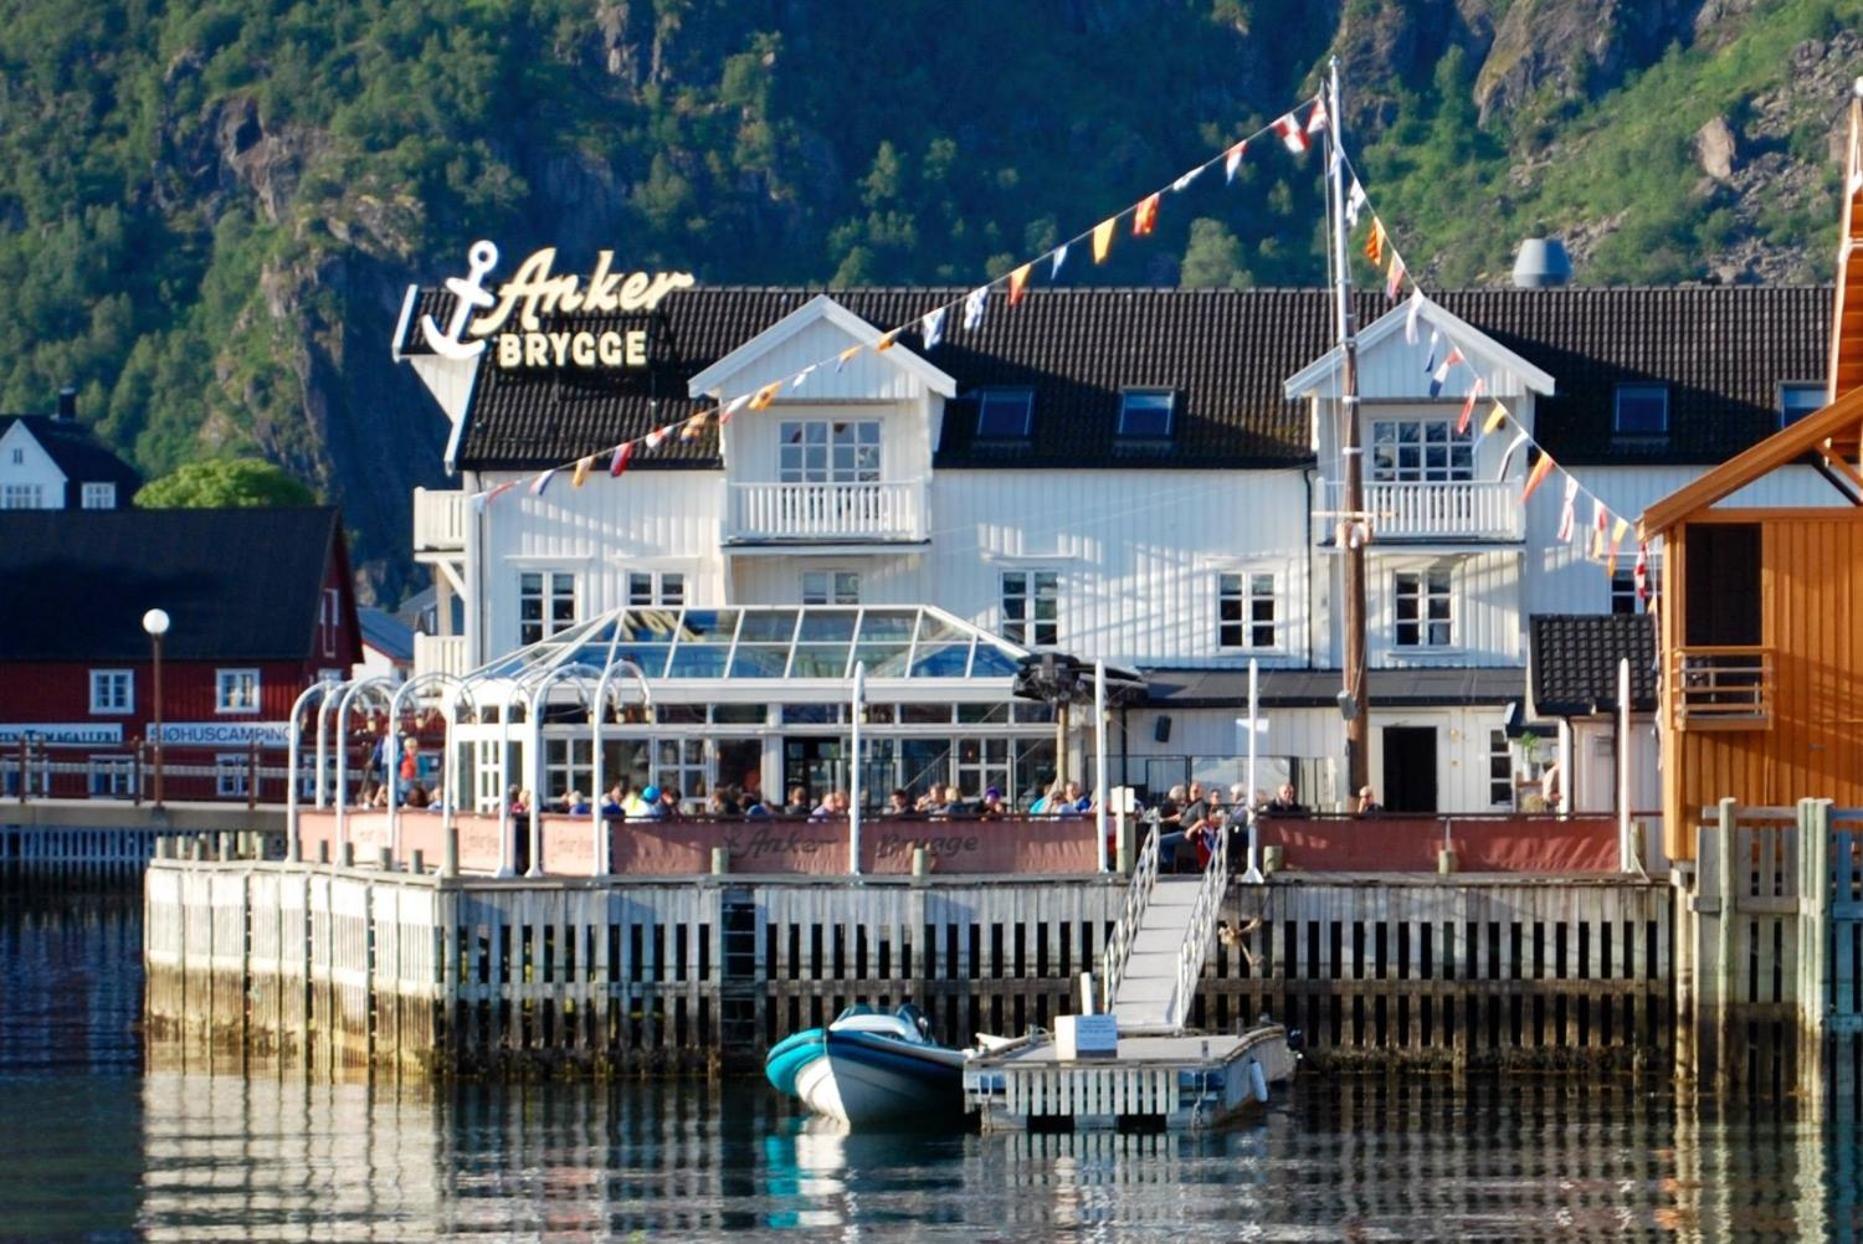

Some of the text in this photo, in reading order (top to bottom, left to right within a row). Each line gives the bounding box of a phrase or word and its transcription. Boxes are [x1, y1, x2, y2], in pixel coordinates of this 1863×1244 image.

[470, 247, 695, 335] Anker
[499, 331, 647, 367] BRYGGE
[727, 827, 839, 859] Anker
